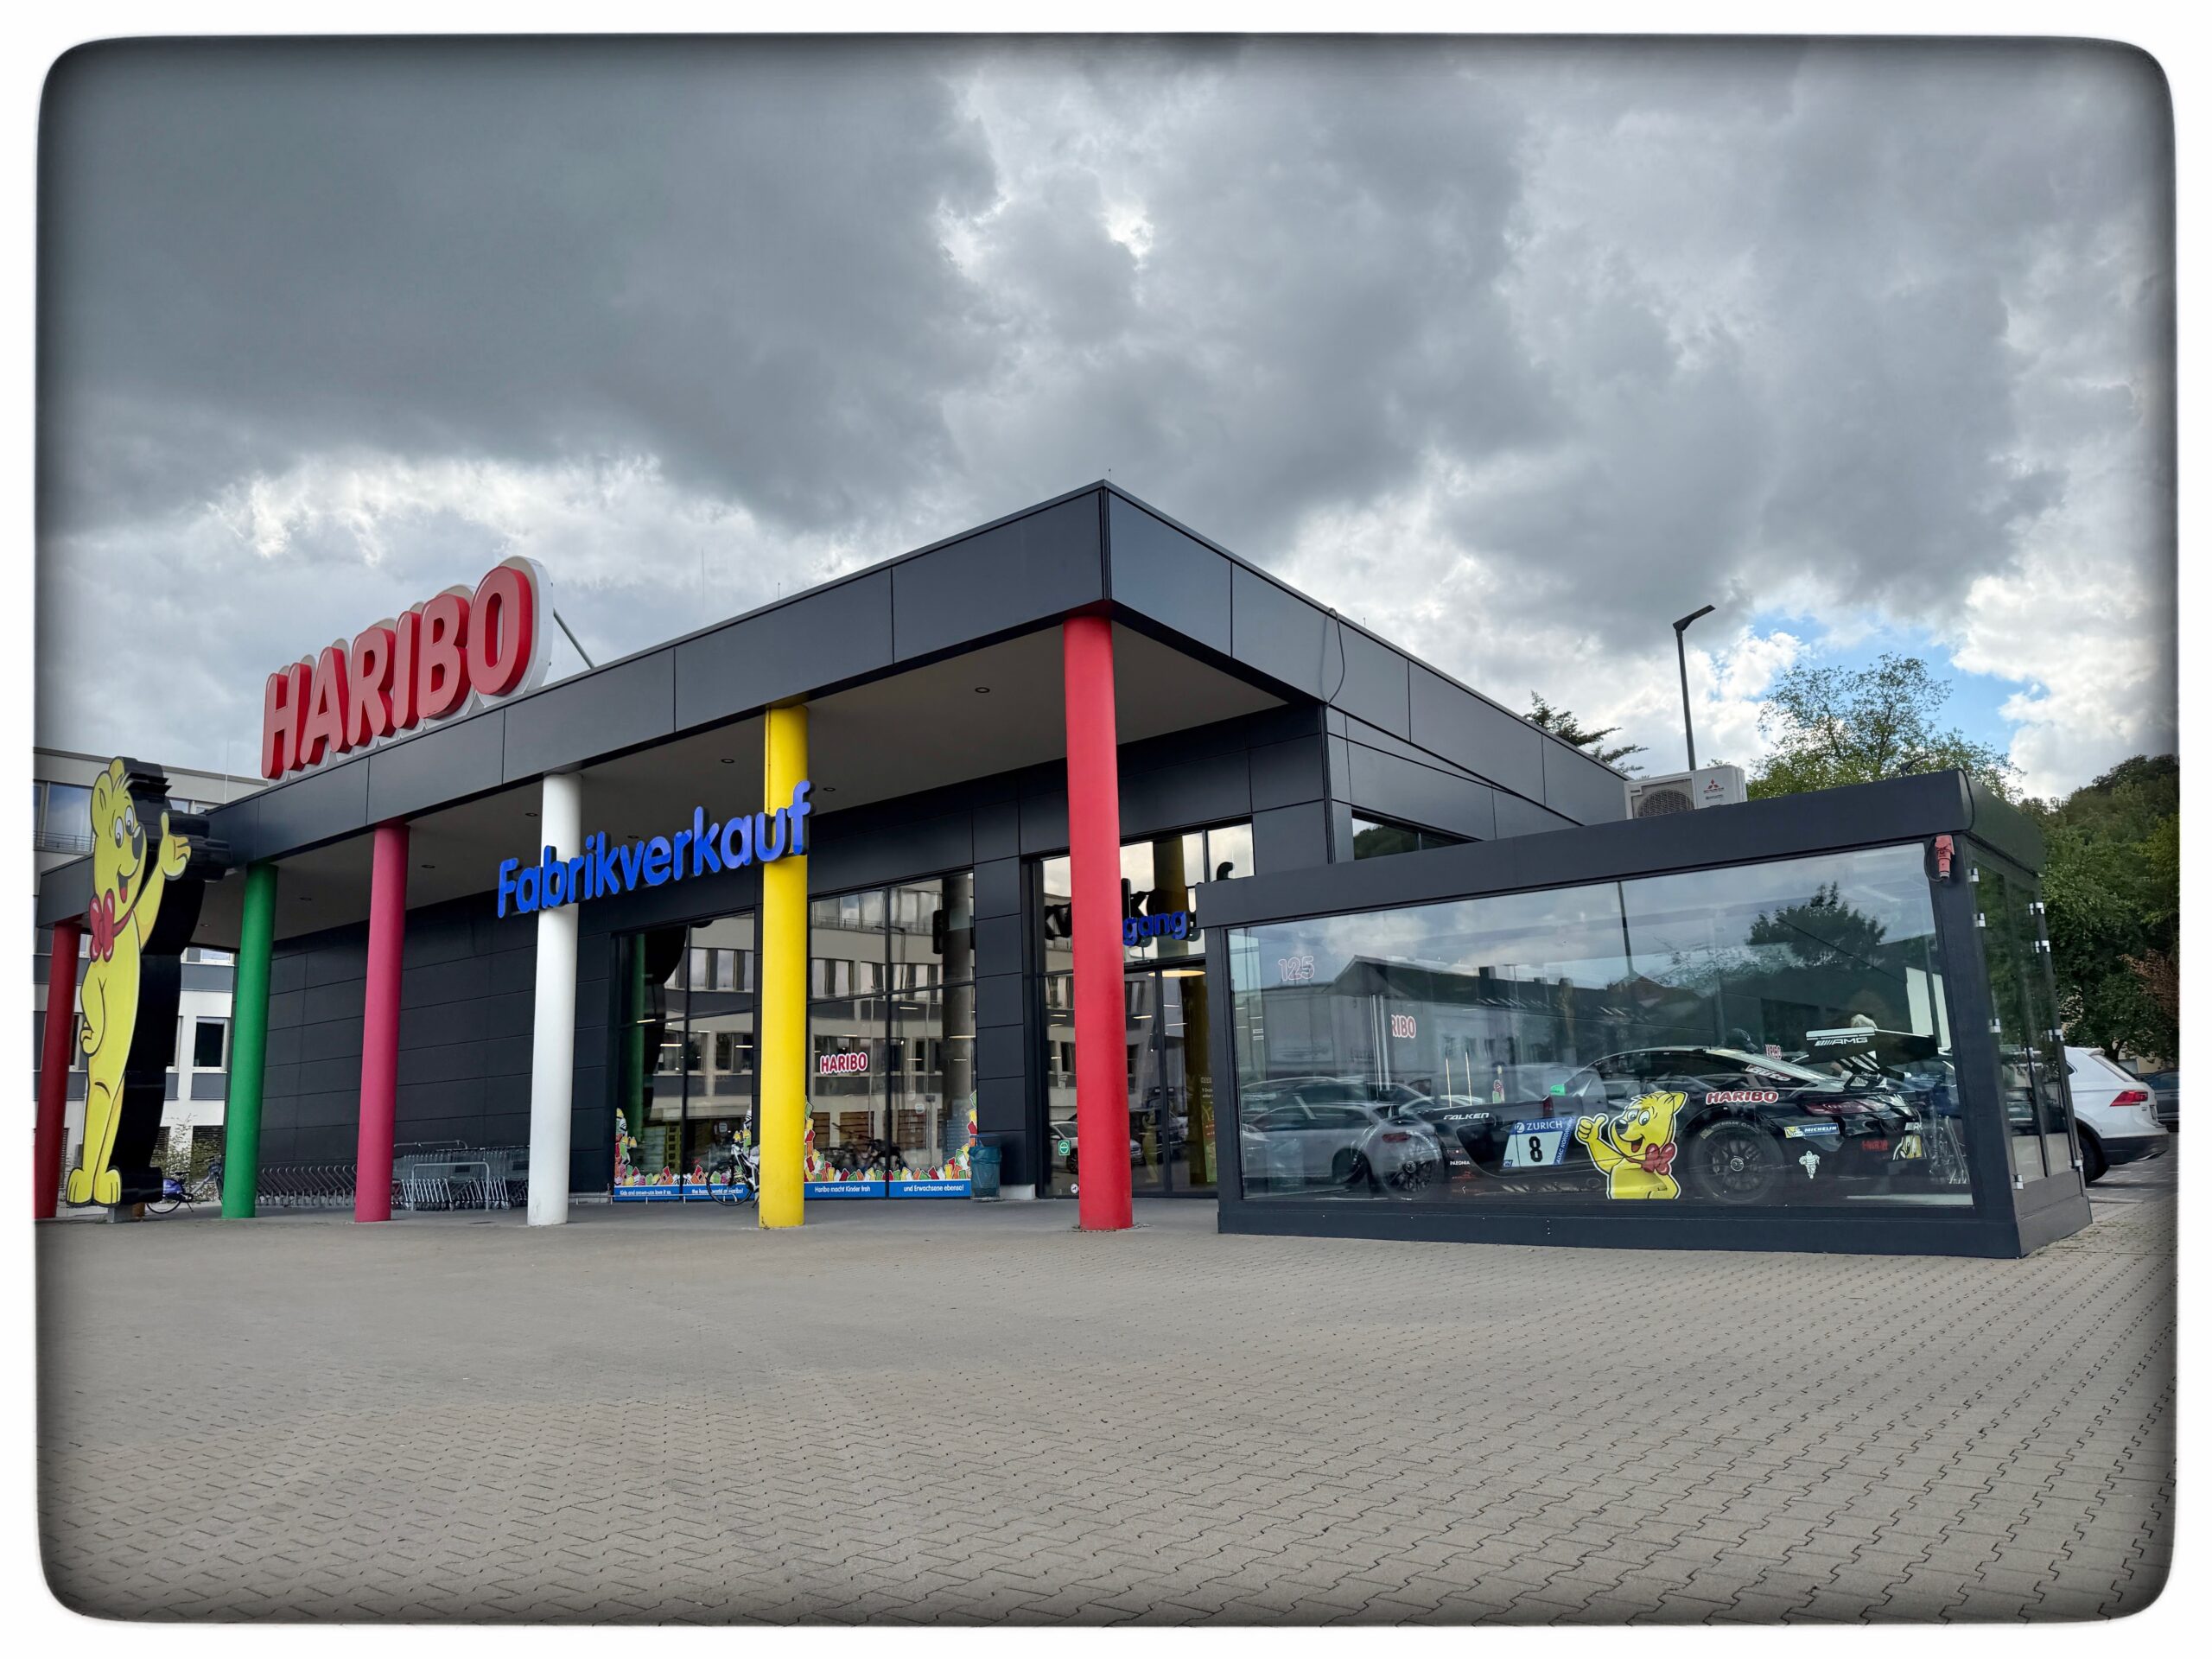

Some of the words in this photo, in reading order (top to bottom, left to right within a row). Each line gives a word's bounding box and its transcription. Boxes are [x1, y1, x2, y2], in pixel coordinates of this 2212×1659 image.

[262, 565, 534, 779] HARIBO
[498, 780, 813, 918] Fabrikverkauf
[1122, 912, 1187, 947] gang
[1278, 956, 1314, 982] 125
[1391, 1014, 1416, 1039] RIBO
[820, 1052, 868, 1074] HARIBO
[1706, 1090, 1778, 1104] HARIBO
[1443, 1112, 1490, 1121] FALKEN
[1526, 1120, 1563, 1131] ZURICH
[1529, 1135, 1543, 1163] 8
